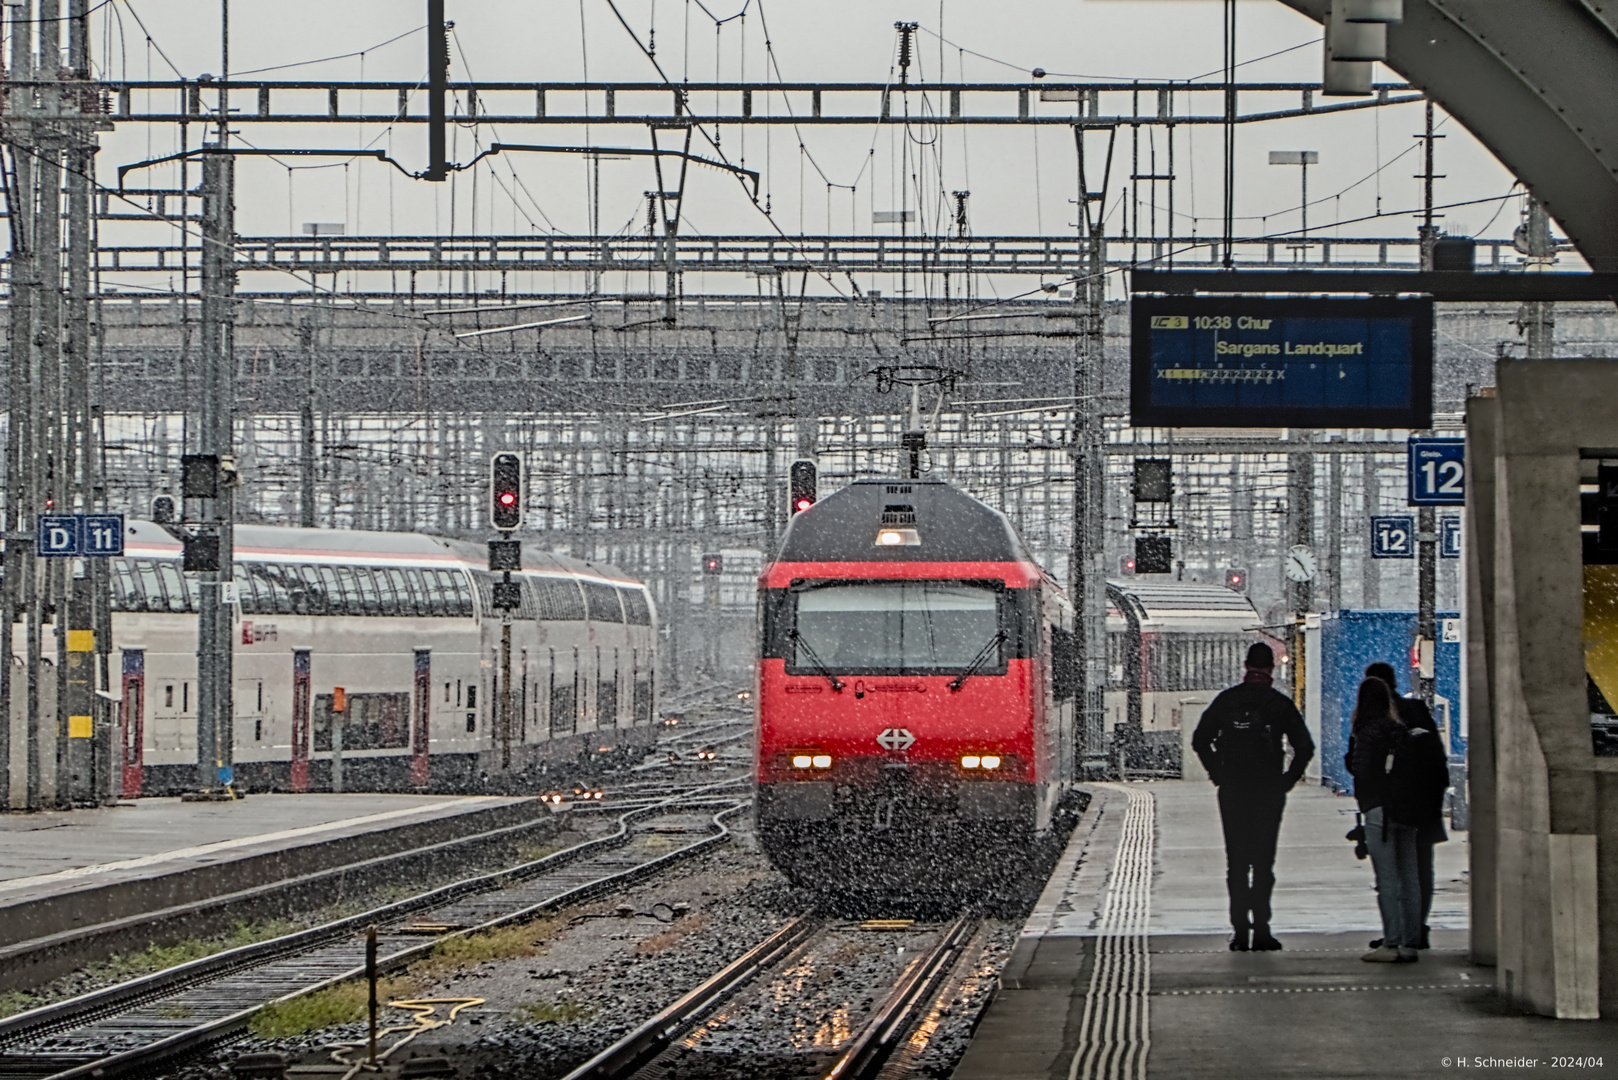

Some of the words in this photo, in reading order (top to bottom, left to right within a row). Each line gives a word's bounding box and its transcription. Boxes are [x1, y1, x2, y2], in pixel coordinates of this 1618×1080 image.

[1174, 317, 1182, 327] 3
[1193, 316, 1232, 329] 10:38
[1237, 316, 1272, 329] Chur
[1217, 341, 1280, 357] Sargans
[1285, 341, 1363, 357] Landquart
[1421, 460, 1463, 493] 12
[50, 528, 69, 549] D
[92, 528, 112, 549] 11
[1379, 529, 1406, 551] 12
